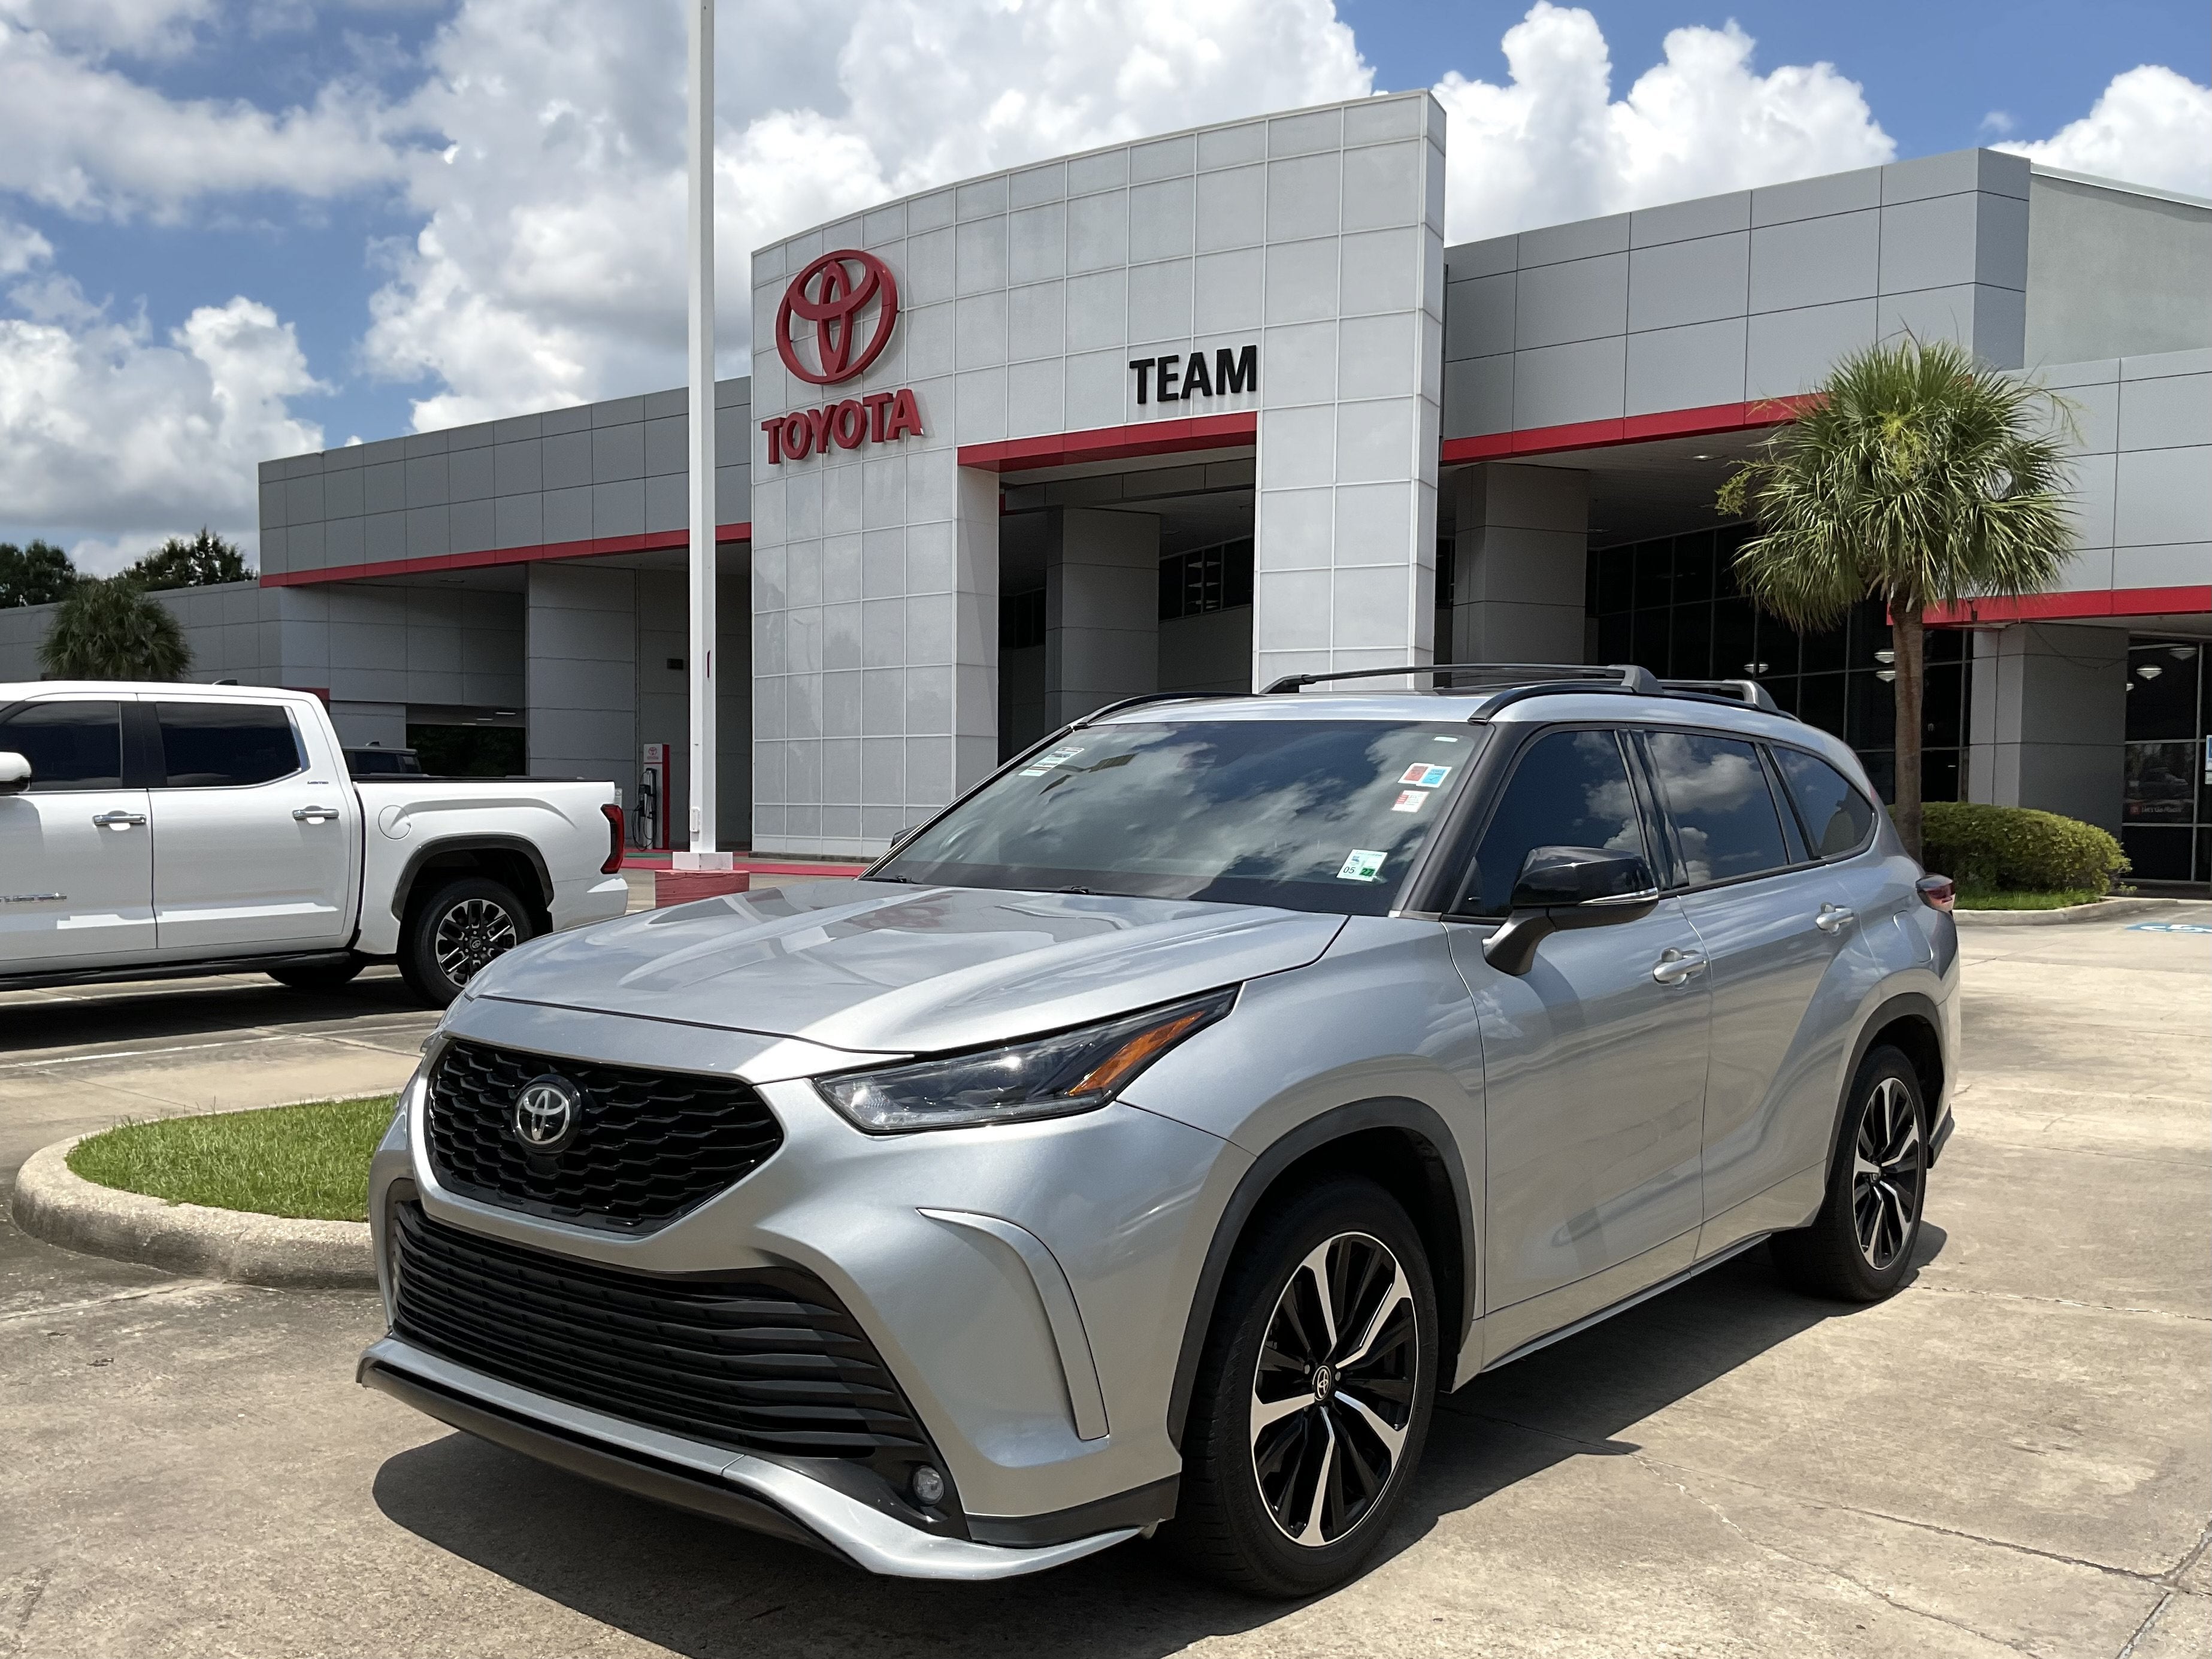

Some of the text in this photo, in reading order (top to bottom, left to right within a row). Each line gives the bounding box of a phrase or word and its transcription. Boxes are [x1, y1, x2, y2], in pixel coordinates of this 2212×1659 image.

[1129, 344, 1257, 404] TEAM
[761, 388, 924, 465] TOYOTA
[1360, 868, 1375, 876] 27
